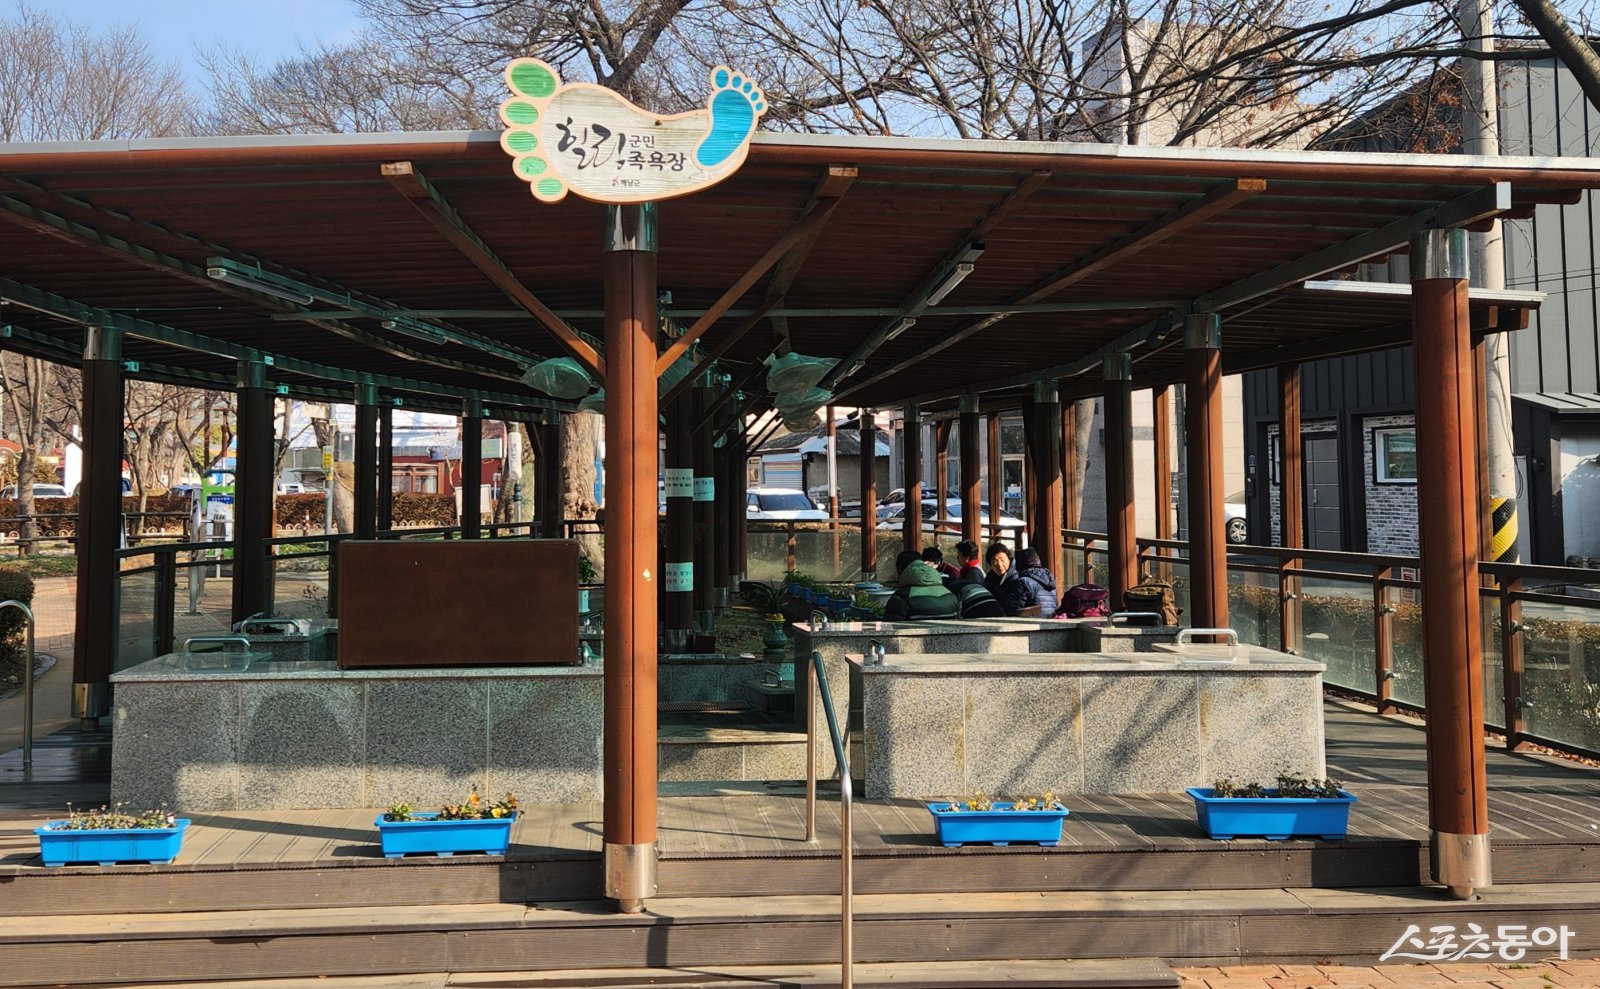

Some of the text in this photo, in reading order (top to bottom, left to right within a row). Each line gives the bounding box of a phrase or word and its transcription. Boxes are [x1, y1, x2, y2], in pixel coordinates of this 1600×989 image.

[555, 116, 626, 170] 힐링
[629, 135, 655, 148] 군민
[627, 151, 687, 171] 족욕장
